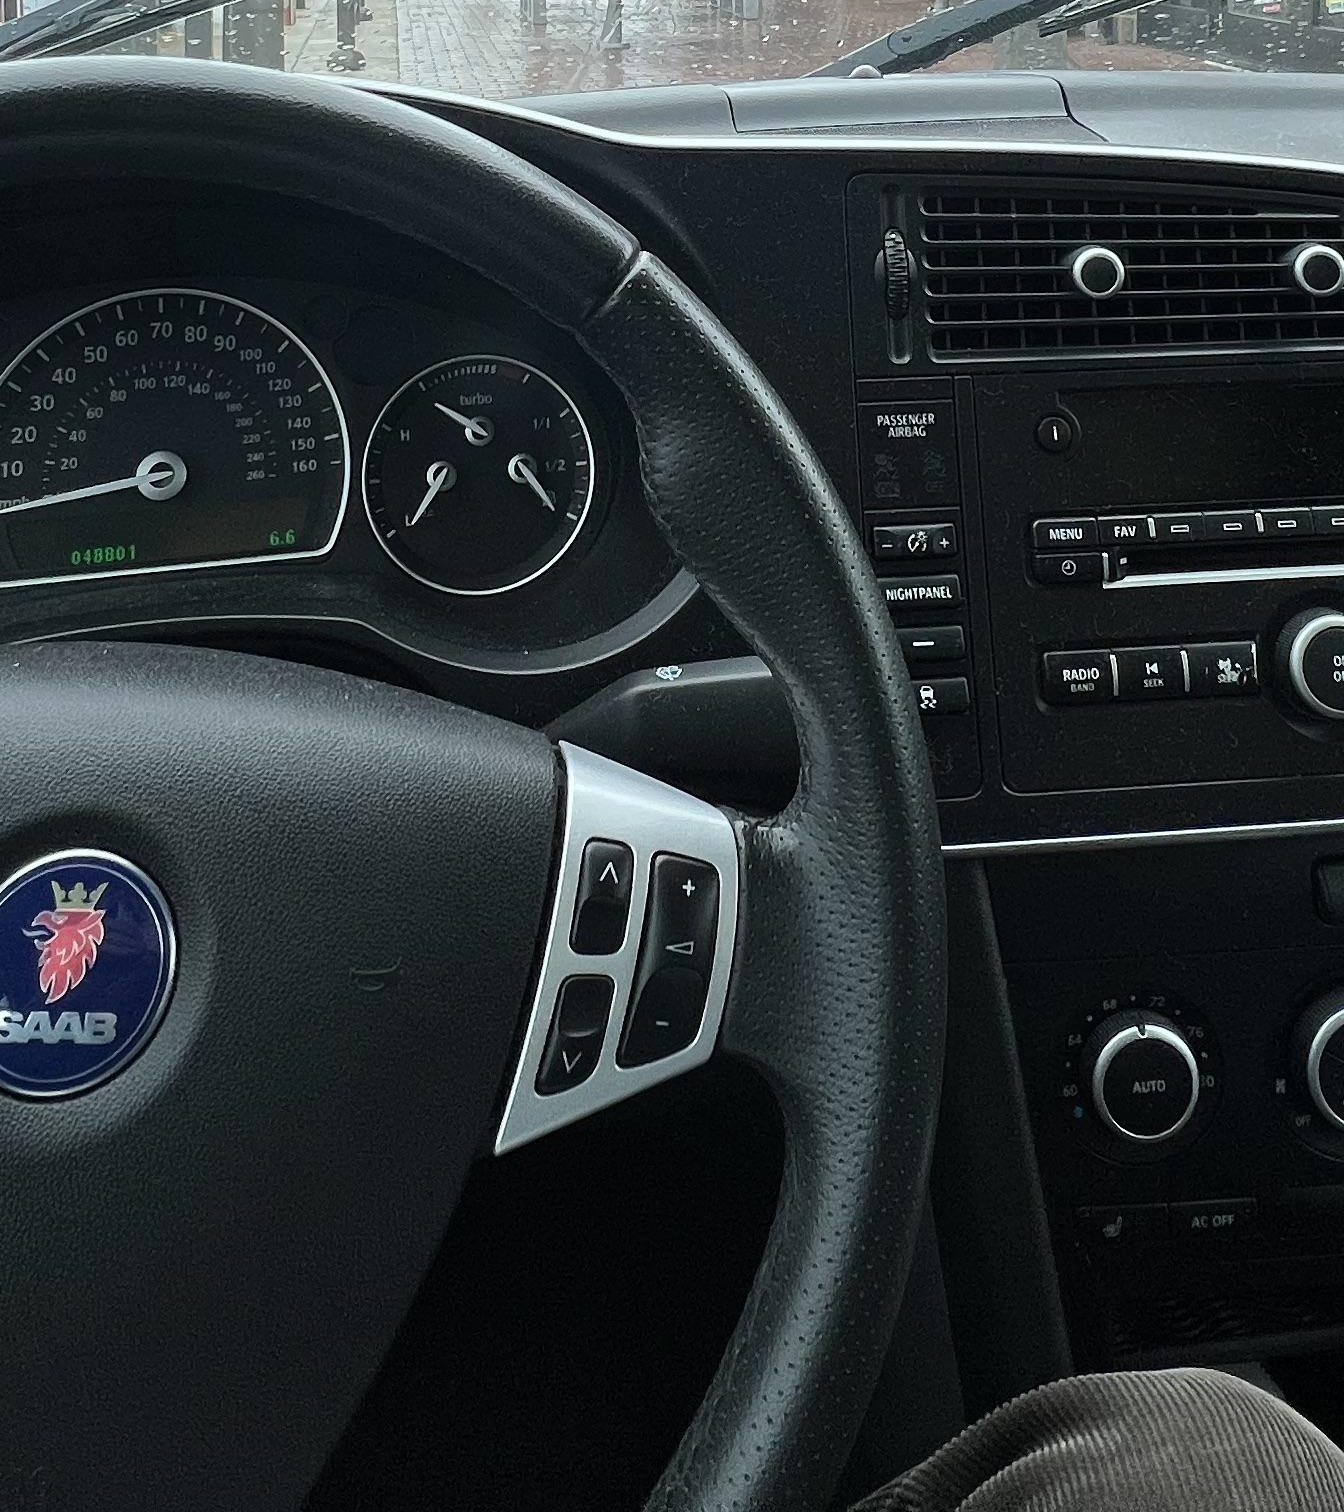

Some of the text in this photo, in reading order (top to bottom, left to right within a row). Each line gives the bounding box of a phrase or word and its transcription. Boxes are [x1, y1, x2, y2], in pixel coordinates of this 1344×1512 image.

[150, 321, 173, 338] 70
[185, 326, 207, 343] 80
[115, 330, 138, 347] 60
[214, 334, 236, 352] 90
[84, 346, 108, 364] 50
[239, 347, 262, 361] 100
[255, 361, 276, 374] 110
[51, 367, 76, 384] 40
[133, 376, 156, 389] 100
[163, 373, 186, 388] 120
[188, 381, 210, 395] 140
[268, 377, 292, 391] 120
[110, 389, 127, 403] 80
[278, 394, 302, 408] 130
[459, 392, 493, 407] turbo
[30, 395, 55, 412] 30
[86, 406, 104, 420] 60
[235, 417, 253, 428] 200
[287, 415, 311, 429] 140
[532, 417, 552, 430] 1/1
[876, 413, 936, 428] PASSENGER
[11, 426, 38, 444] 20
[68, 429, 87, 443] 40
[242, 433, 261, 445] 220
[400, 429, 411, 442] H
[887, 425, 927, 439] AIRBAG
[291, 437, 316, 451] 150
[0, 461, 24, 478] 10
[60, 457, 78, 470] 20
[292, 459, 317, 474] 160
[269, 530, 296, 546] 6.6
[1049, 527, 1083, 541] MENU
[1114, 525, 1136, 538] FAV
[71, 545, 137, 566] 048801
[886, 586, 953, 601] NIGHTPANEL
[1062, 667, 1100, 683] RADIO
[1149, 996, 1166, 1008] 72
[1187, 1026, 1204, 1038] 76
[1132, 1079, 1166, 1094] AUTO
[1191, 1214, 1235, 1228] AC OFF
